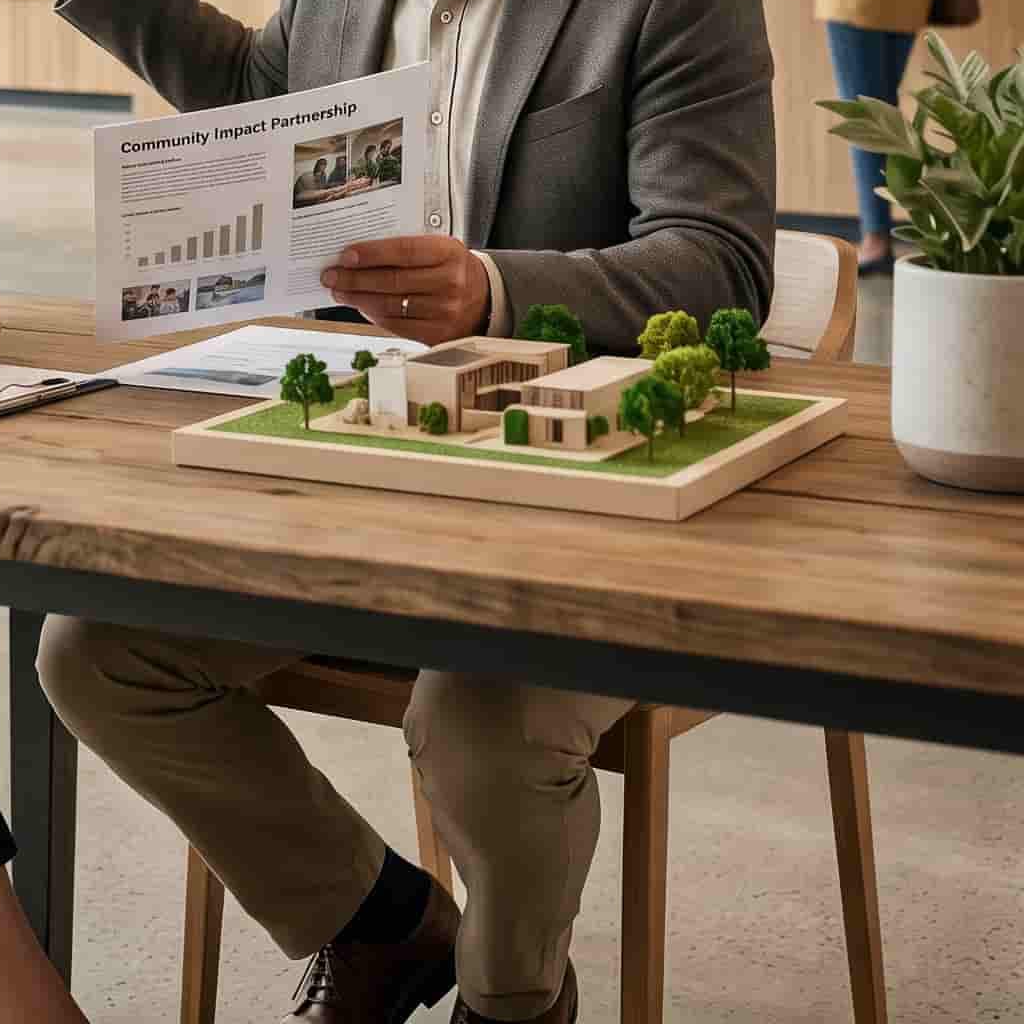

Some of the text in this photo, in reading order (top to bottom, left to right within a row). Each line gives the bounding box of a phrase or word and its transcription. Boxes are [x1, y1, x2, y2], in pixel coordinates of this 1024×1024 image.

[121, 101, 358, 154] Community Impact Partnership
